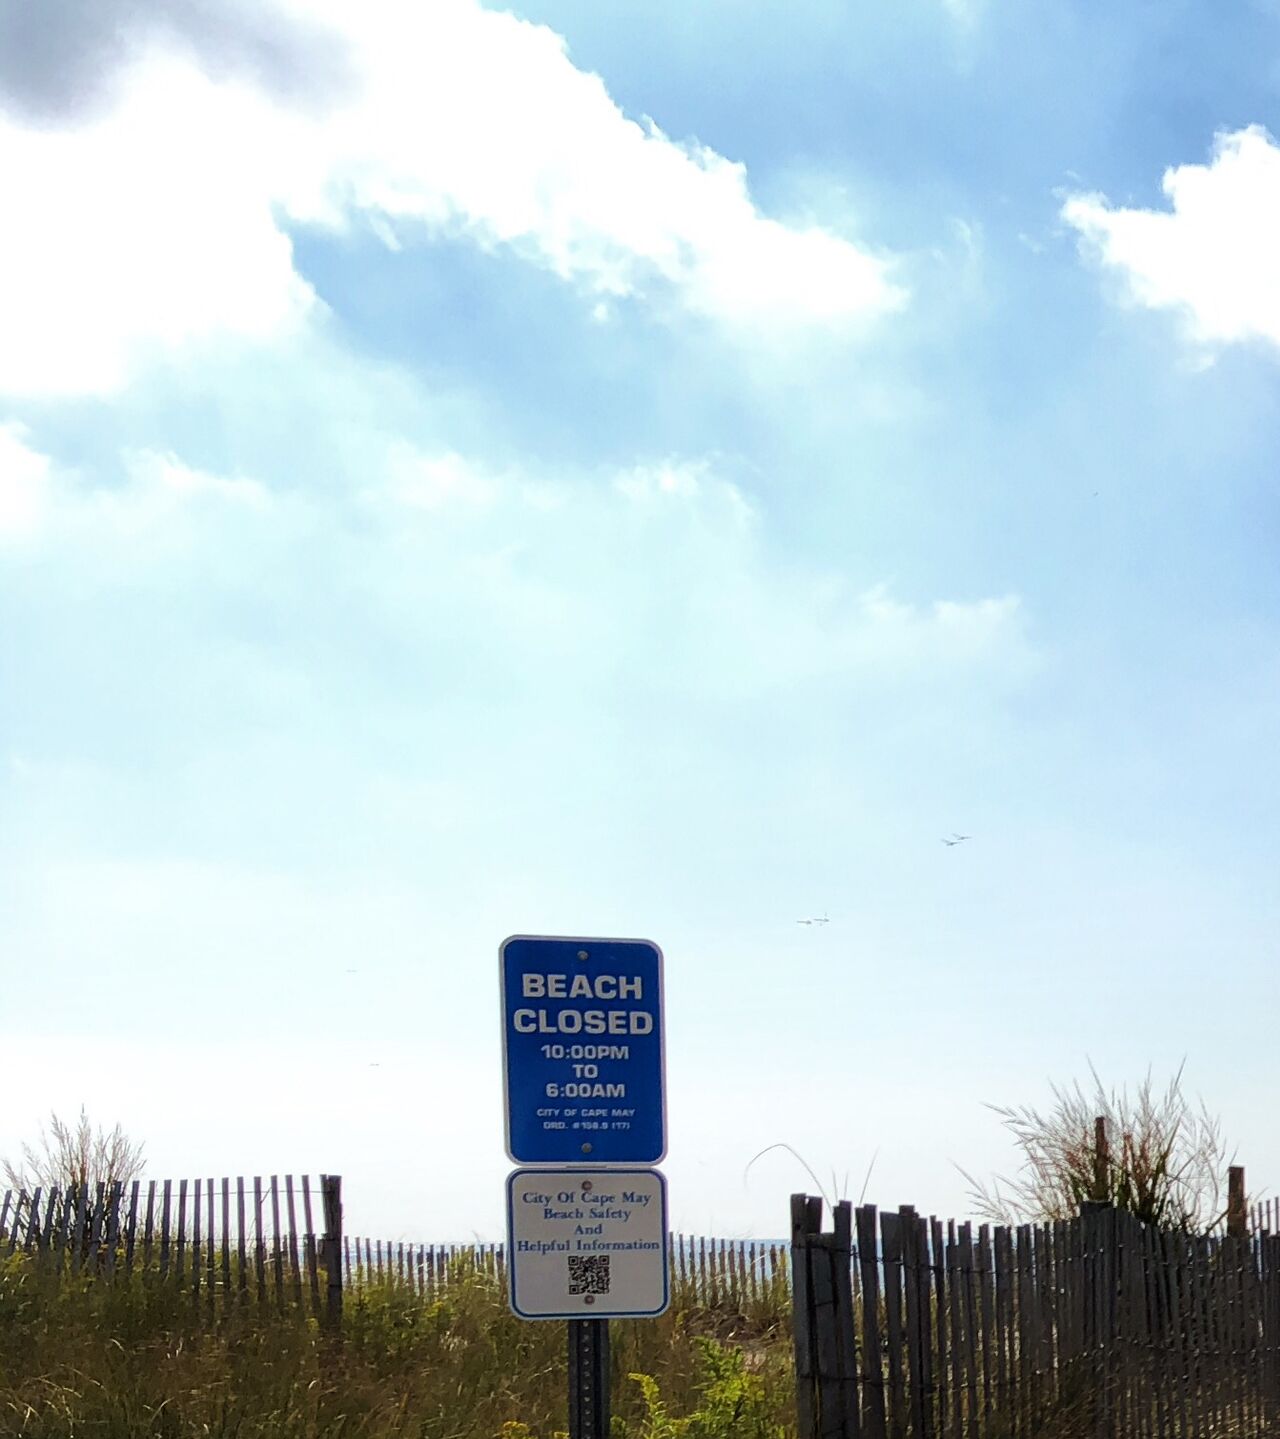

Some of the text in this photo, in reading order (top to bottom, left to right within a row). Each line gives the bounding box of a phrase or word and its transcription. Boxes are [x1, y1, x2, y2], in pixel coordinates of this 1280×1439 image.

[522, 973, 642, 1000] BEACH
[513, 1008, 653, 1035] CLOSED
[541, 1045, 629, 1060] 10:00PM
[572, 1064, 598, 1079] TO
[546, 1083, 625, 1098] 6:00AM
[536, 1109, 635, 1117] CITY OF CAPE MAY
[522, 1191, 651, 1207] City Of Cape May
[543, 1208, 631, 1222] Beach Safety
[574, 1223, 603, 1235] And
[517, 1239, 660, 1254] Helpful Information
